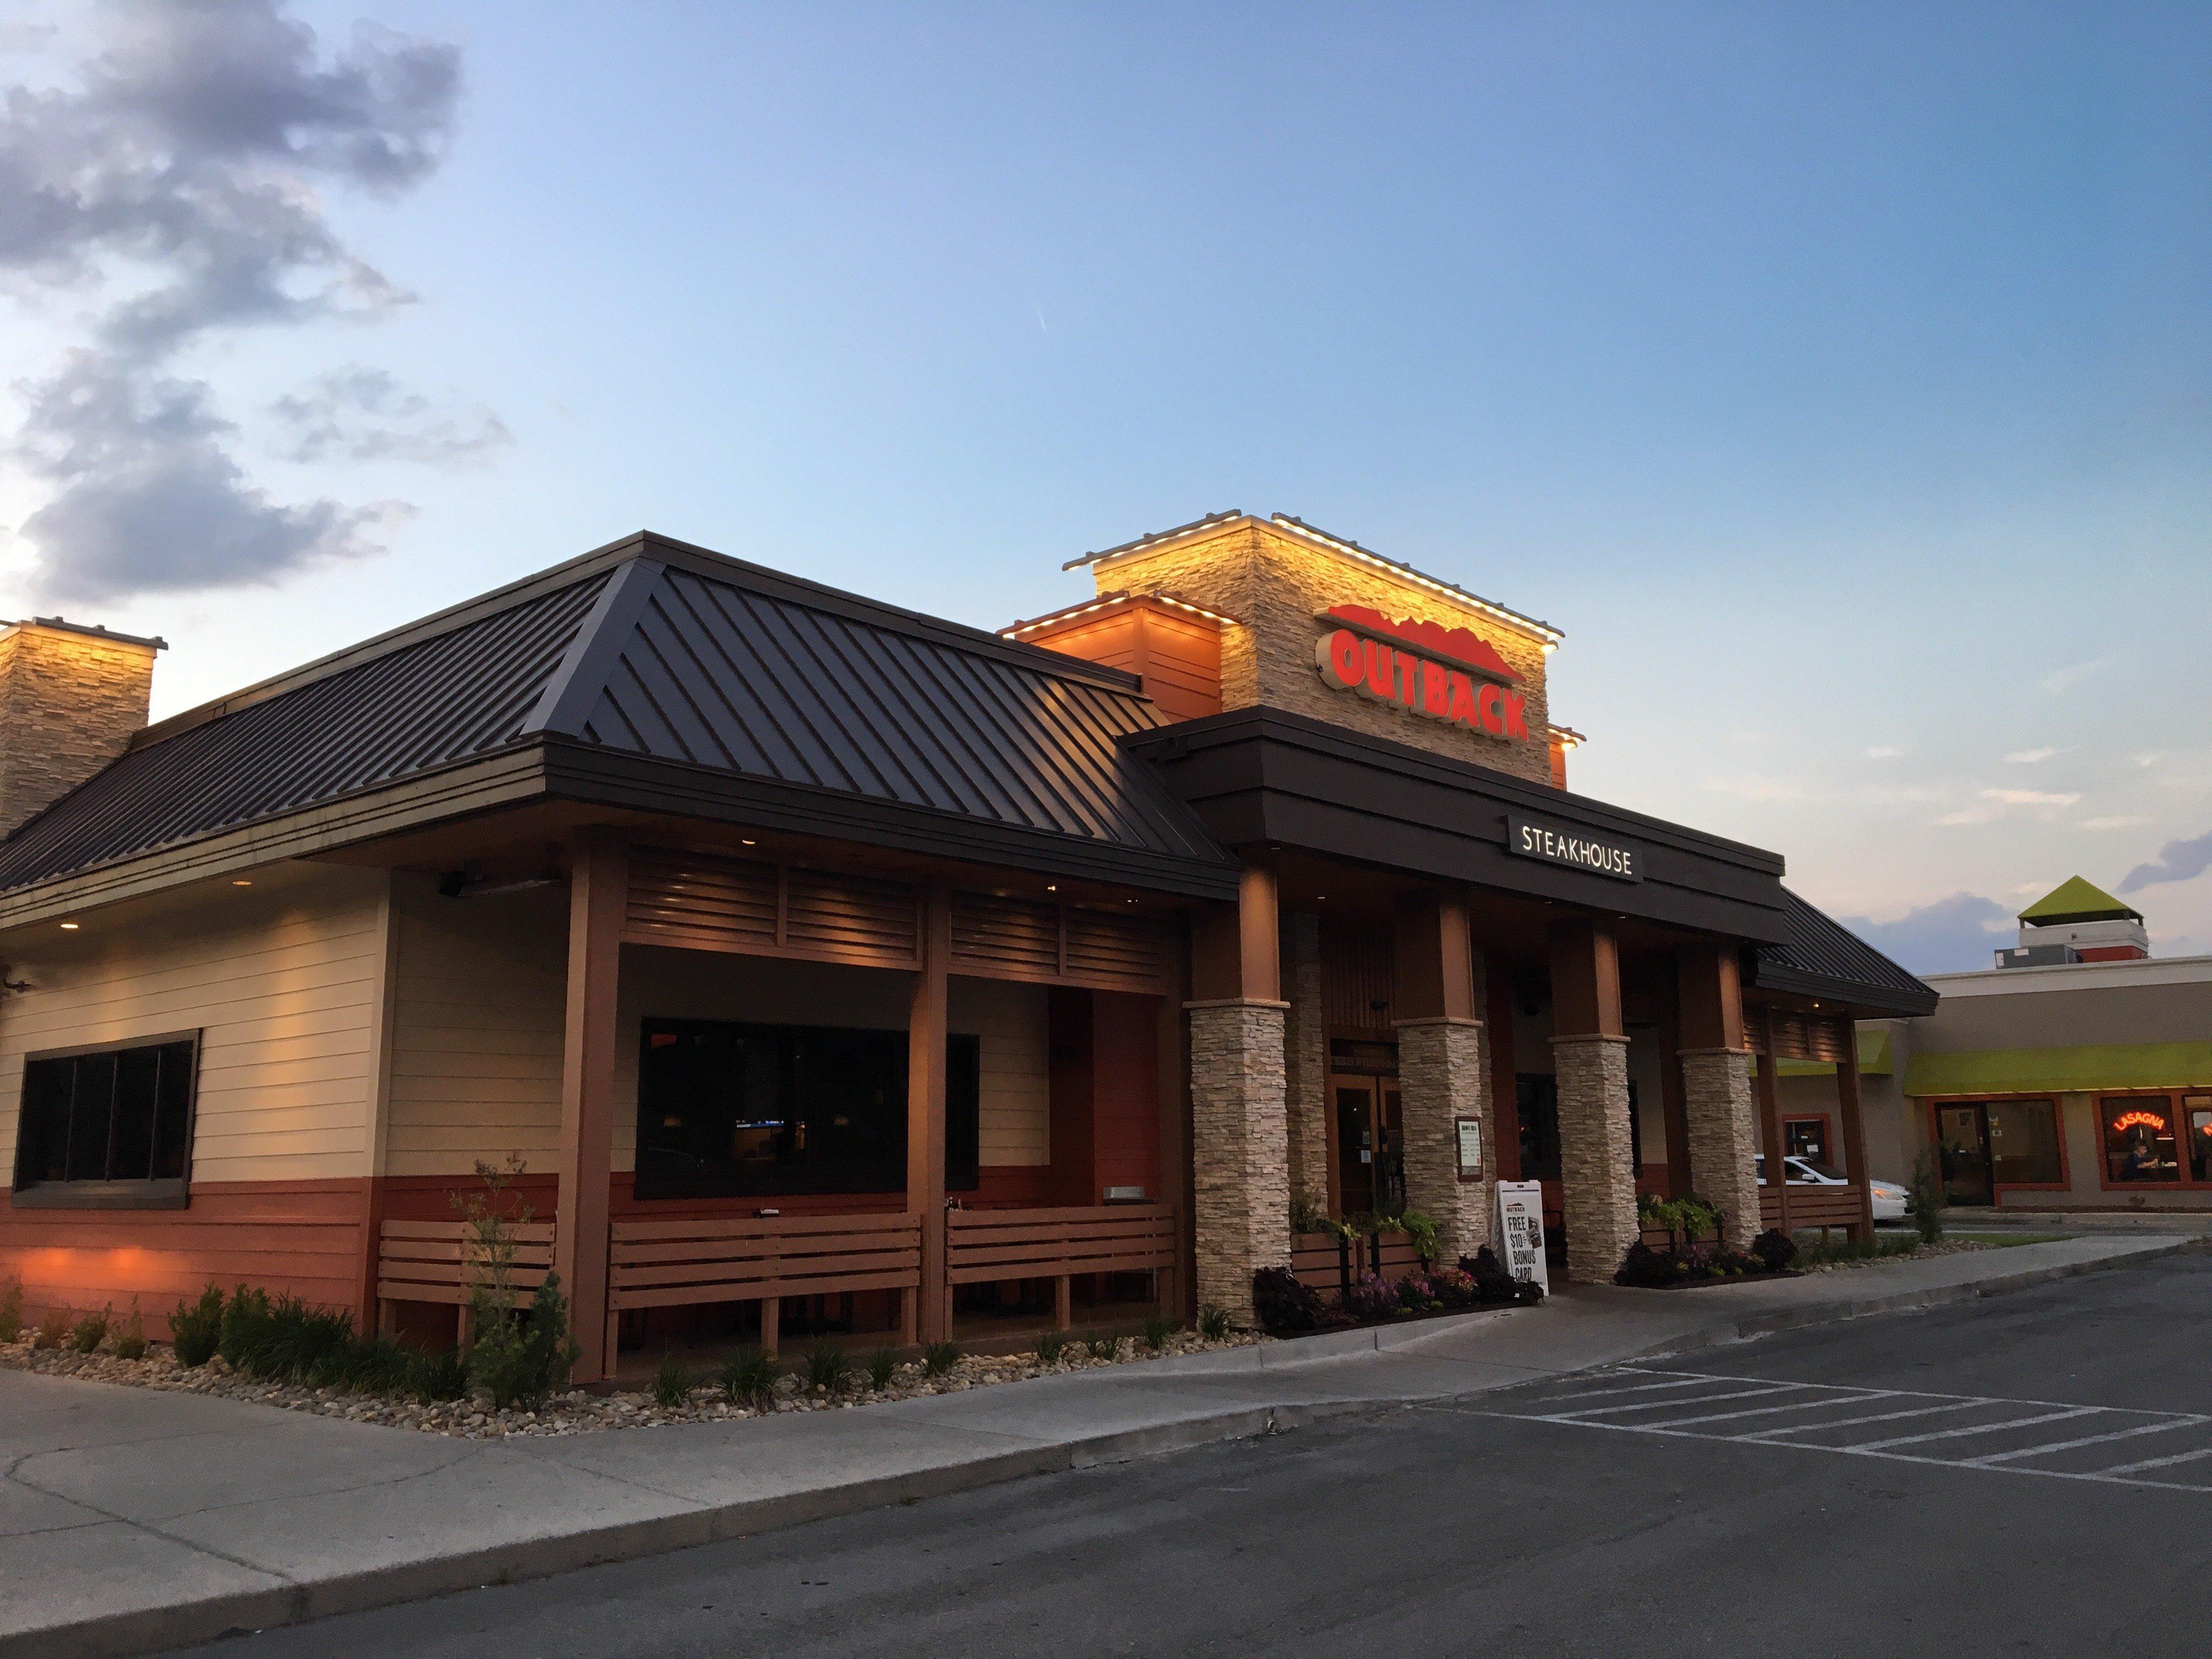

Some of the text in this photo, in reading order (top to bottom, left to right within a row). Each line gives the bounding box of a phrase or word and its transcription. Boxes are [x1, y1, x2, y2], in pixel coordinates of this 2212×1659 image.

[1331, 629, 1528, 743] OUTBACK
[1523, 826, 1632, 874] STEAKHOUSE
[2114, 1112, 2164, 1130] LASAGNA
[1508, 1216, 1526, 1231] FREE
[1510, 1233, 1523, 1249] $10
[1513, 1249, 1536, 1265] BONUS
[1515, 1267, 1532, 1282] CARD
